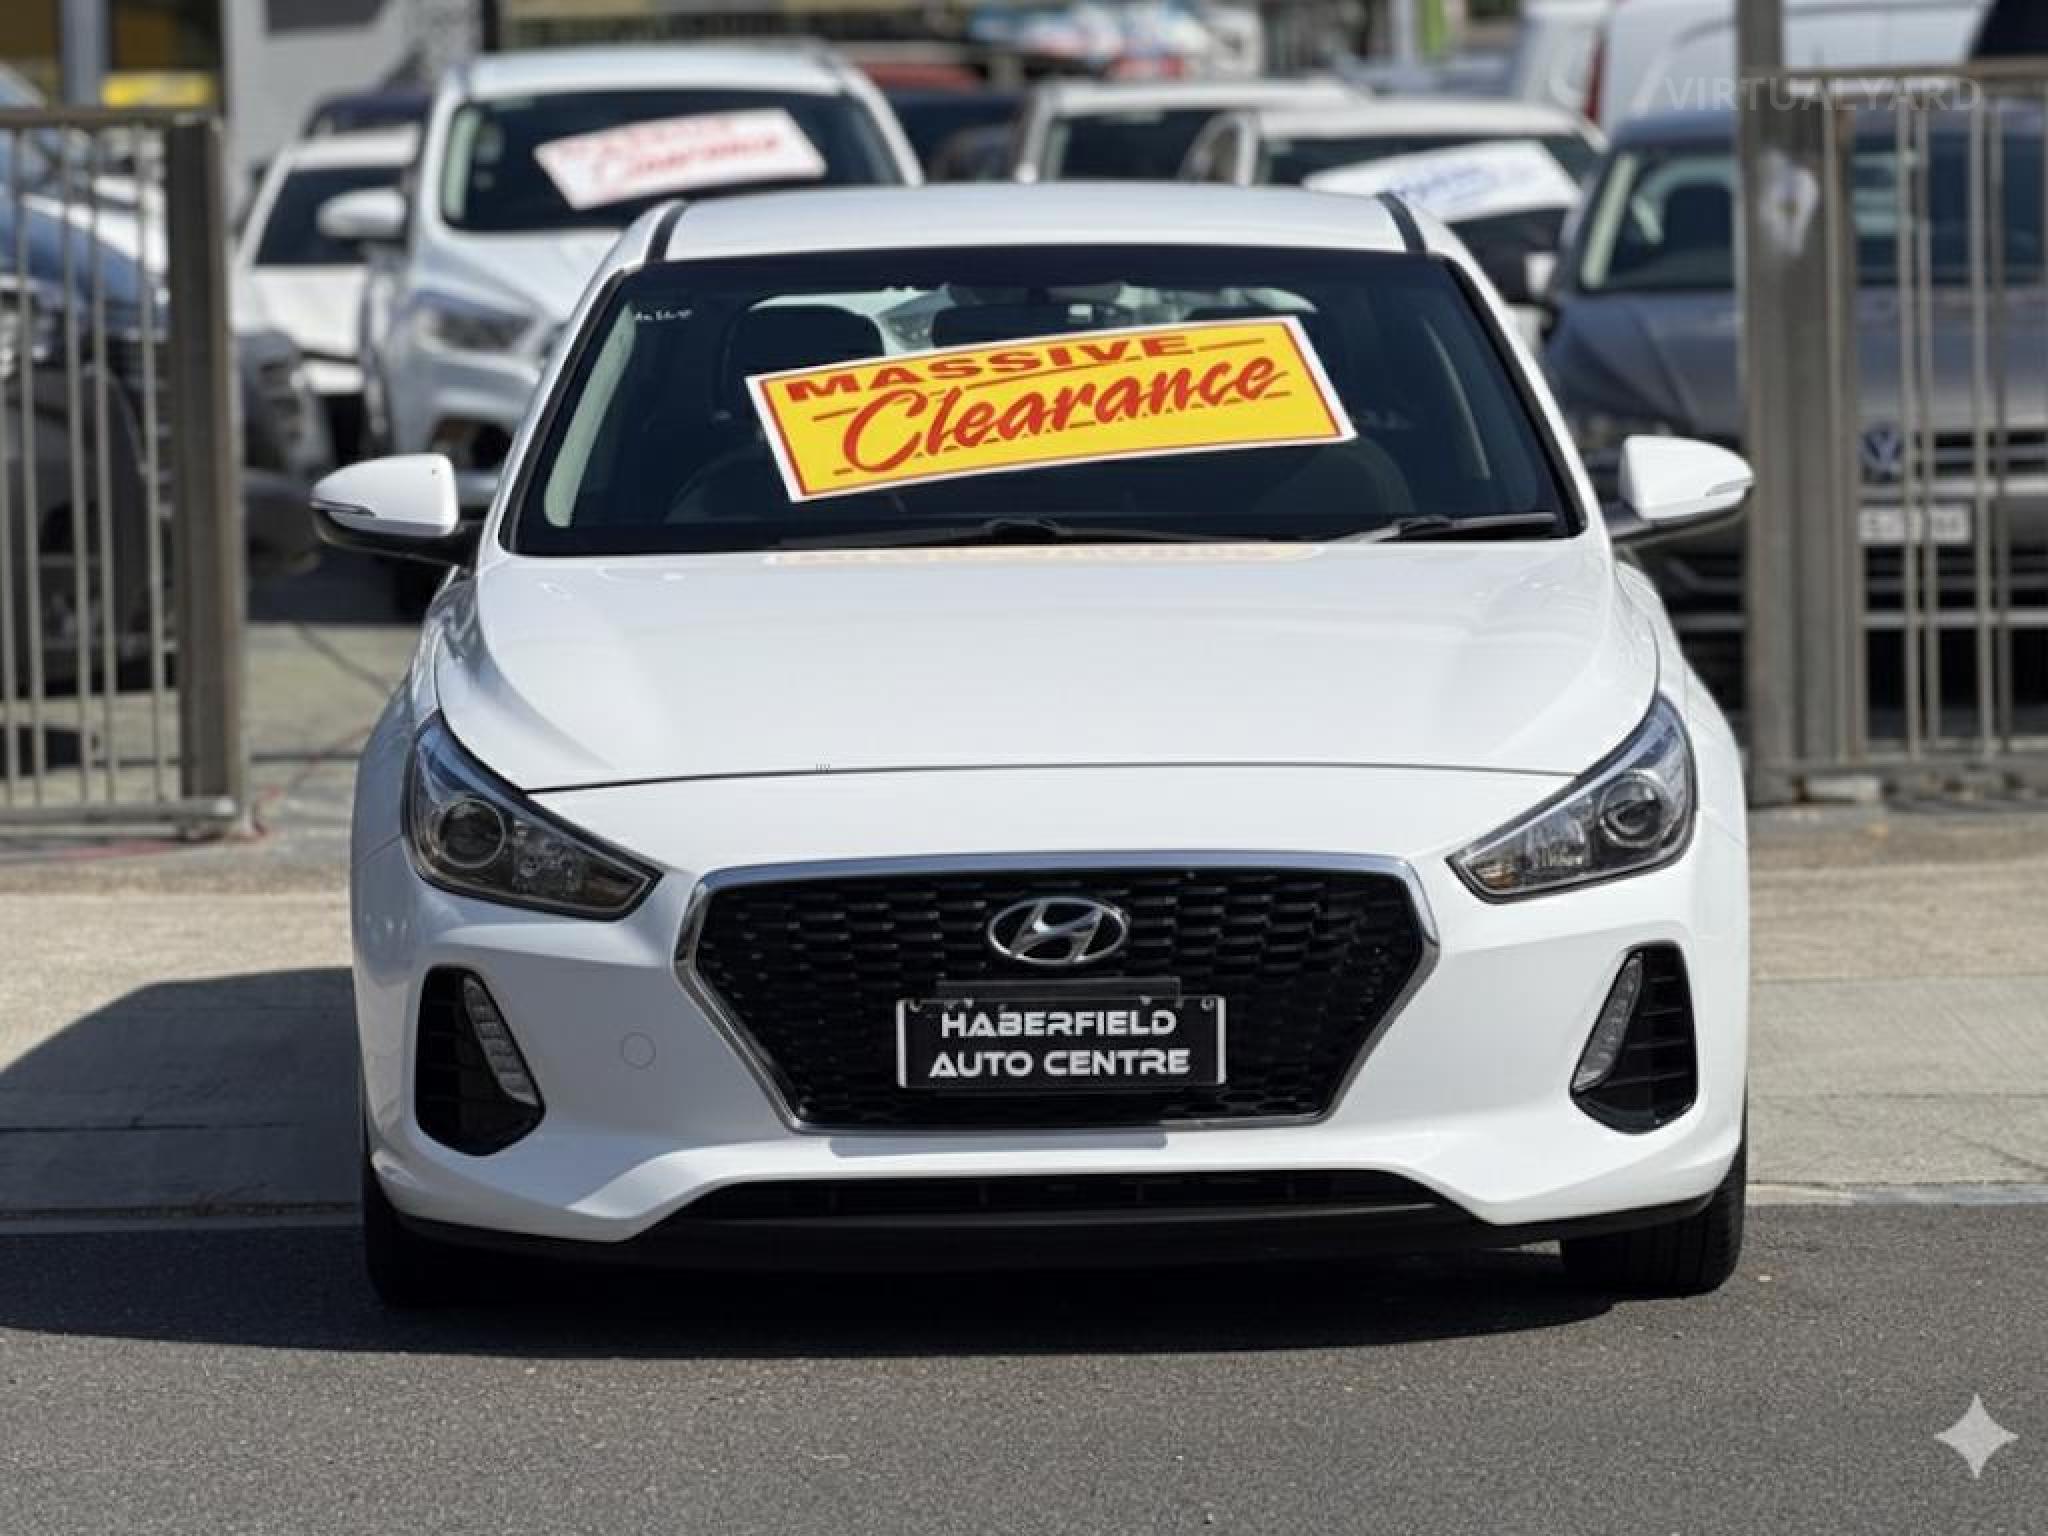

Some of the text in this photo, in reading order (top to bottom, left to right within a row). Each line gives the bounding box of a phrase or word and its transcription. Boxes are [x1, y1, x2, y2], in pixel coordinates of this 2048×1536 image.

[785, 334, 1194, 402] MASSIVE
[842, 355, 1280, 472] Clearance
[941, 1010, 1177, 1039] HABERFIELD
[928, 1049, 1191, 1079] AUTO CENTRE
